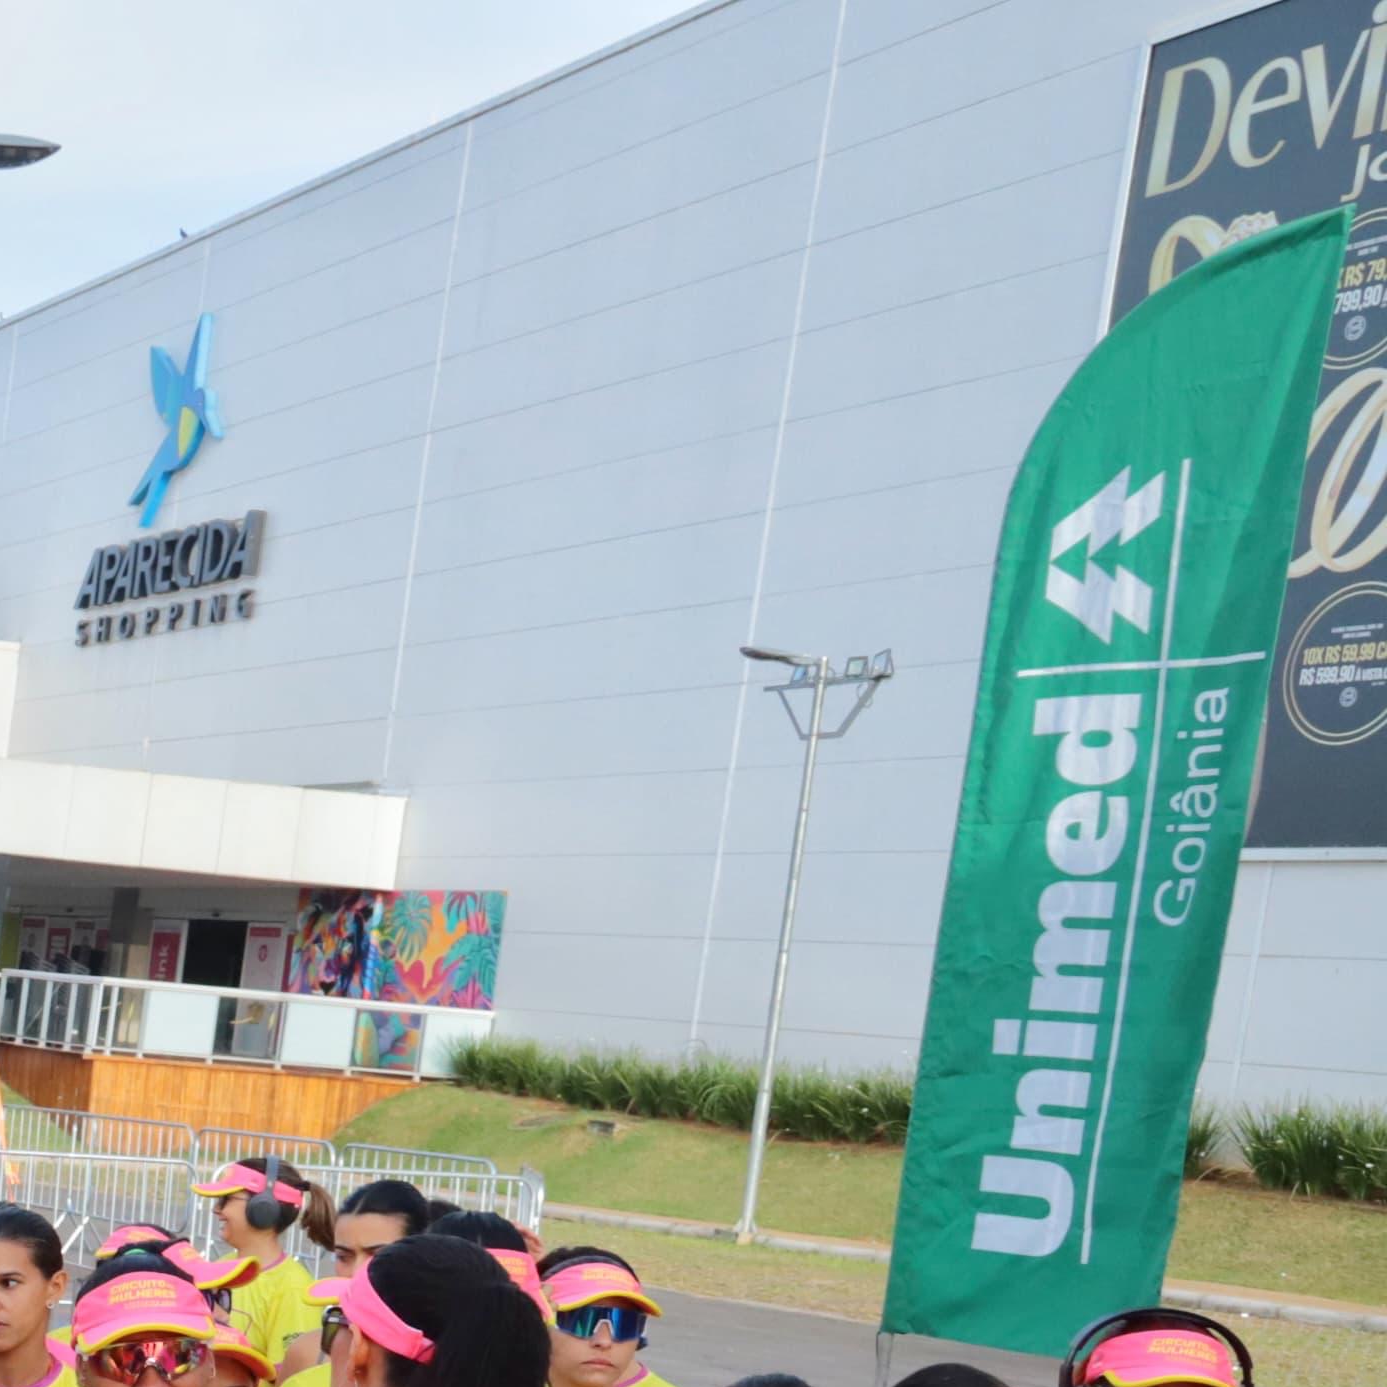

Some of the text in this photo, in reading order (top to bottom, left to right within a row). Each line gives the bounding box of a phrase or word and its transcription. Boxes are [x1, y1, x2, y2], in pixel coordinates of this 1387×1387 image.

[1145, 3, 1387, 198] Devi
[75, 509, 267, 609] APARECIDA
[75, 589, 256, 648] SHOPPING
[1153, 687, 1230, 926] Goiânia
[970, 693, 1140, 1257] Unimed
